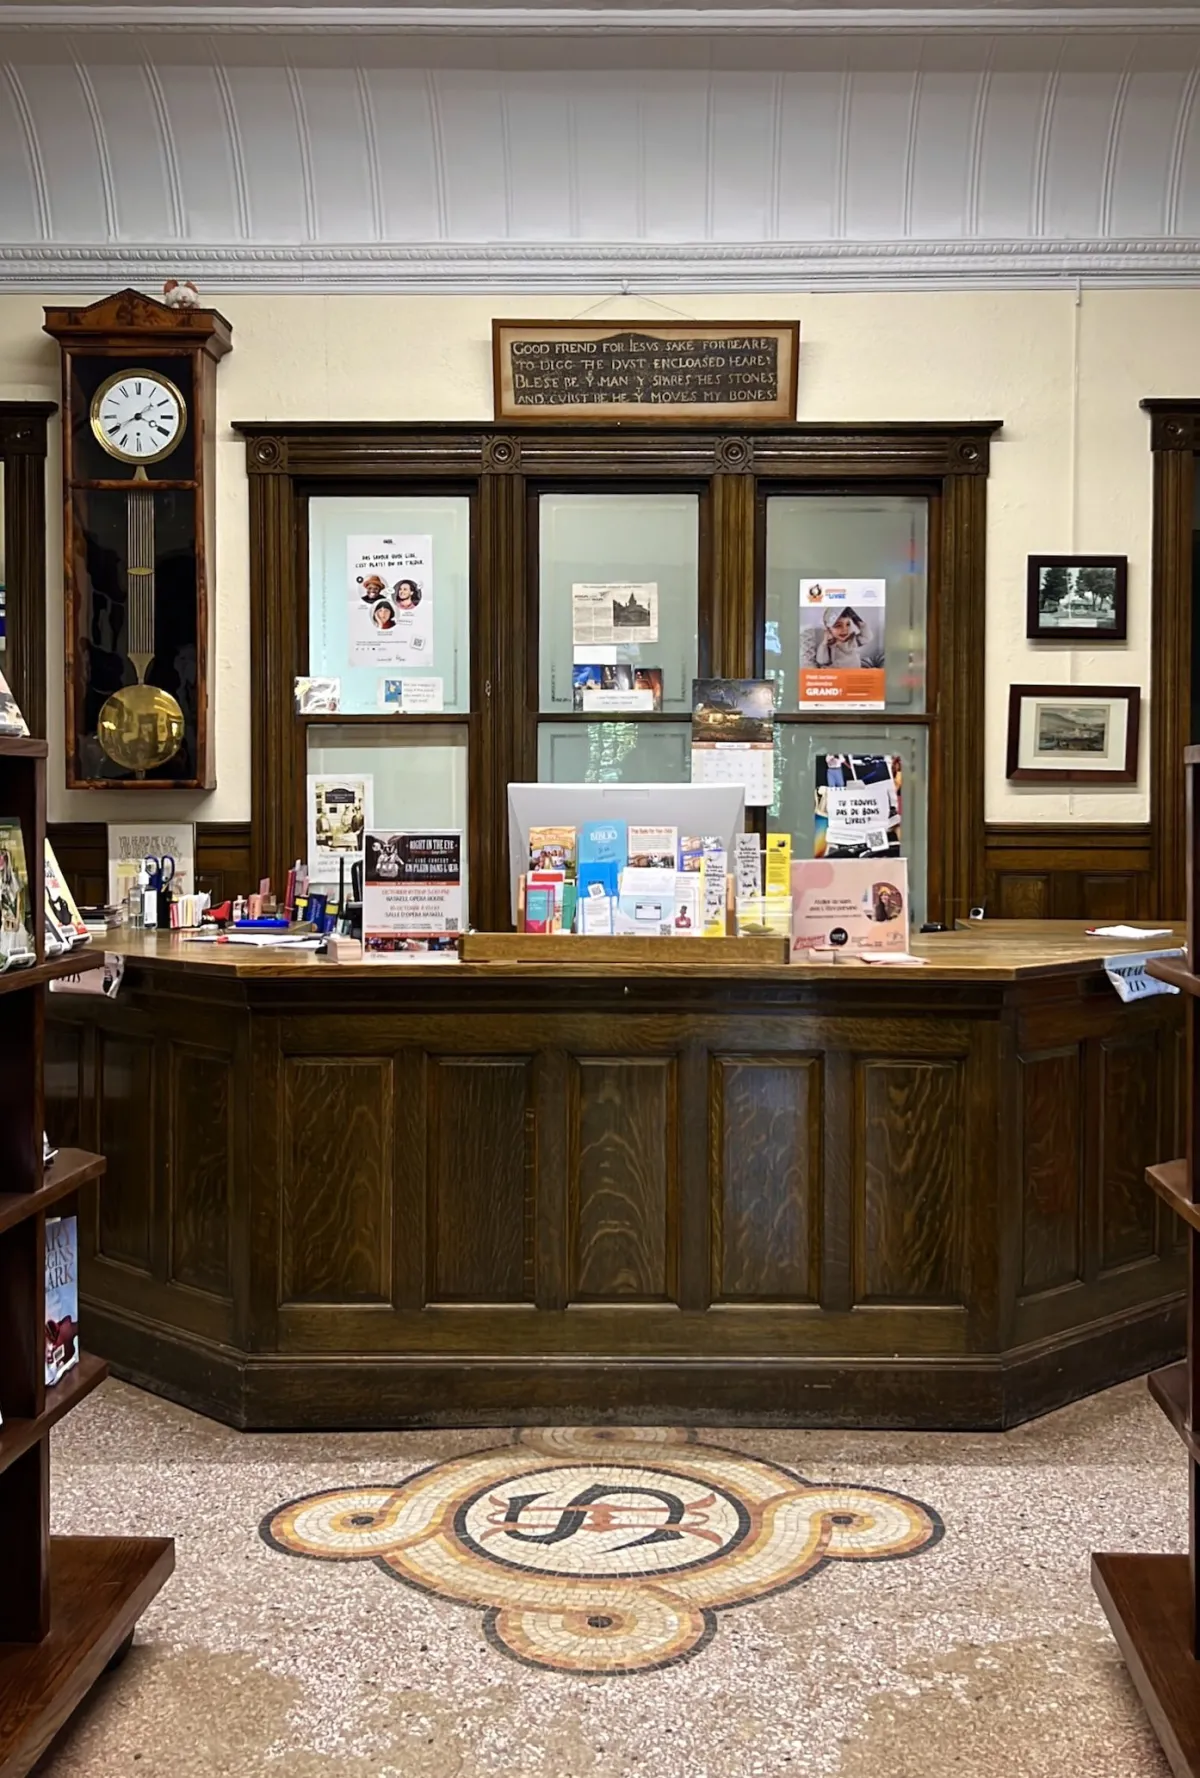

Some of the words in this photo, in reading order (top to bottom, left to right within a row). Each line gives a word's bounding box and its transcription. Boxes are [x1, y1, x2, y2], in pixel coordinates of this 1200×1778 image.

[555, 342, 597, 354] FREND
[602, 342, 624, 353] FOR
[666, 341, 695, 351] SAKE
[516, 360, 535, 371] TO
[581, 359, 604, 370] THE
[653, 356, 725, 369] ENCLOASED
[515, 373, 559, 388] BLESE
[564, 376, 579, 388] BE
[600, 375, 628, 387] MAN
[517, 392, 544, 404] AND
[612, 392, 627, 403] HE
[651, 390, 697, 402] MOVES
[704, 390, 721, 402] MY
[45, 1222, 70, 1252] ARY
[46, 1244, 74, 1270] GINS
[46, 1262, 74, 1291] ARK
